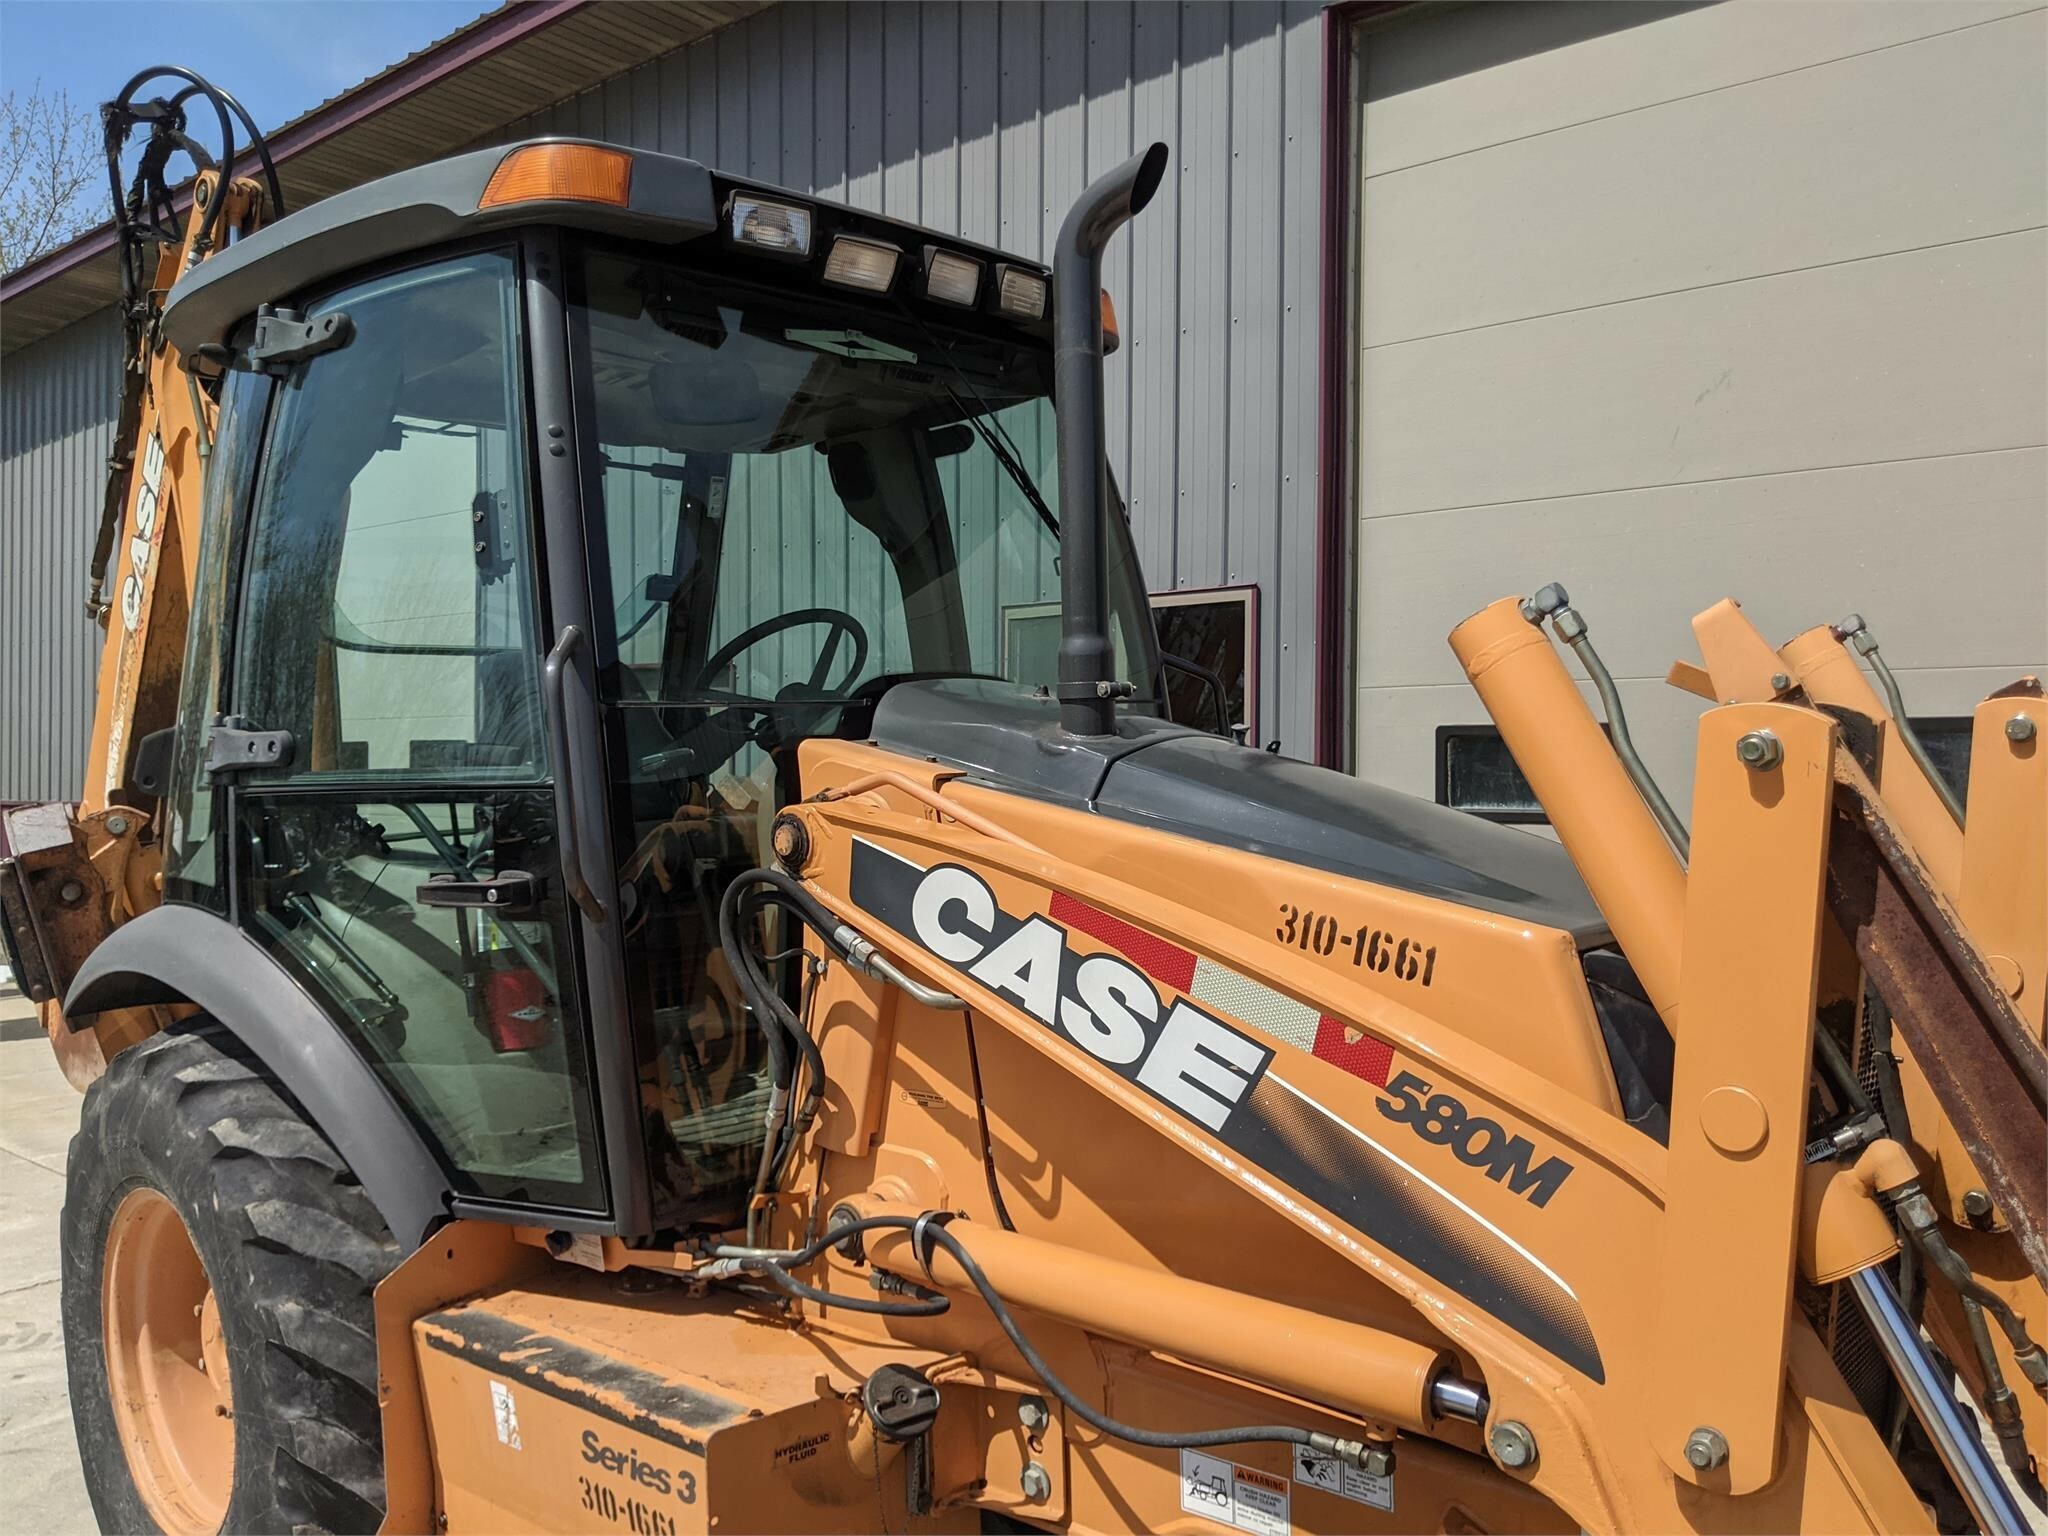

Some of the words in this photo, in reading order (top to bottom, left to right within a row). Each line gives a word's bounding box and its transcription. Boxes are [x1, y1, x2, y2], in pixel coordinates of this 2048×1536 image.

[121, 431, 165, 632] CASE
[1276, 903, 1437, 987] 310-1661
[911, 867, 1267, 1133] CASE
[1375, 1070, 1576, 1210] 580M
[581, 1429, 672, 1495] Series
[676, 1470, 697, 1505] 3
[774, 1432, 830, 1460] HYDRAULIC
[789, 1447, 817, 1464] FLUID
[1247, 1471, 1284, 1493] WARNING
